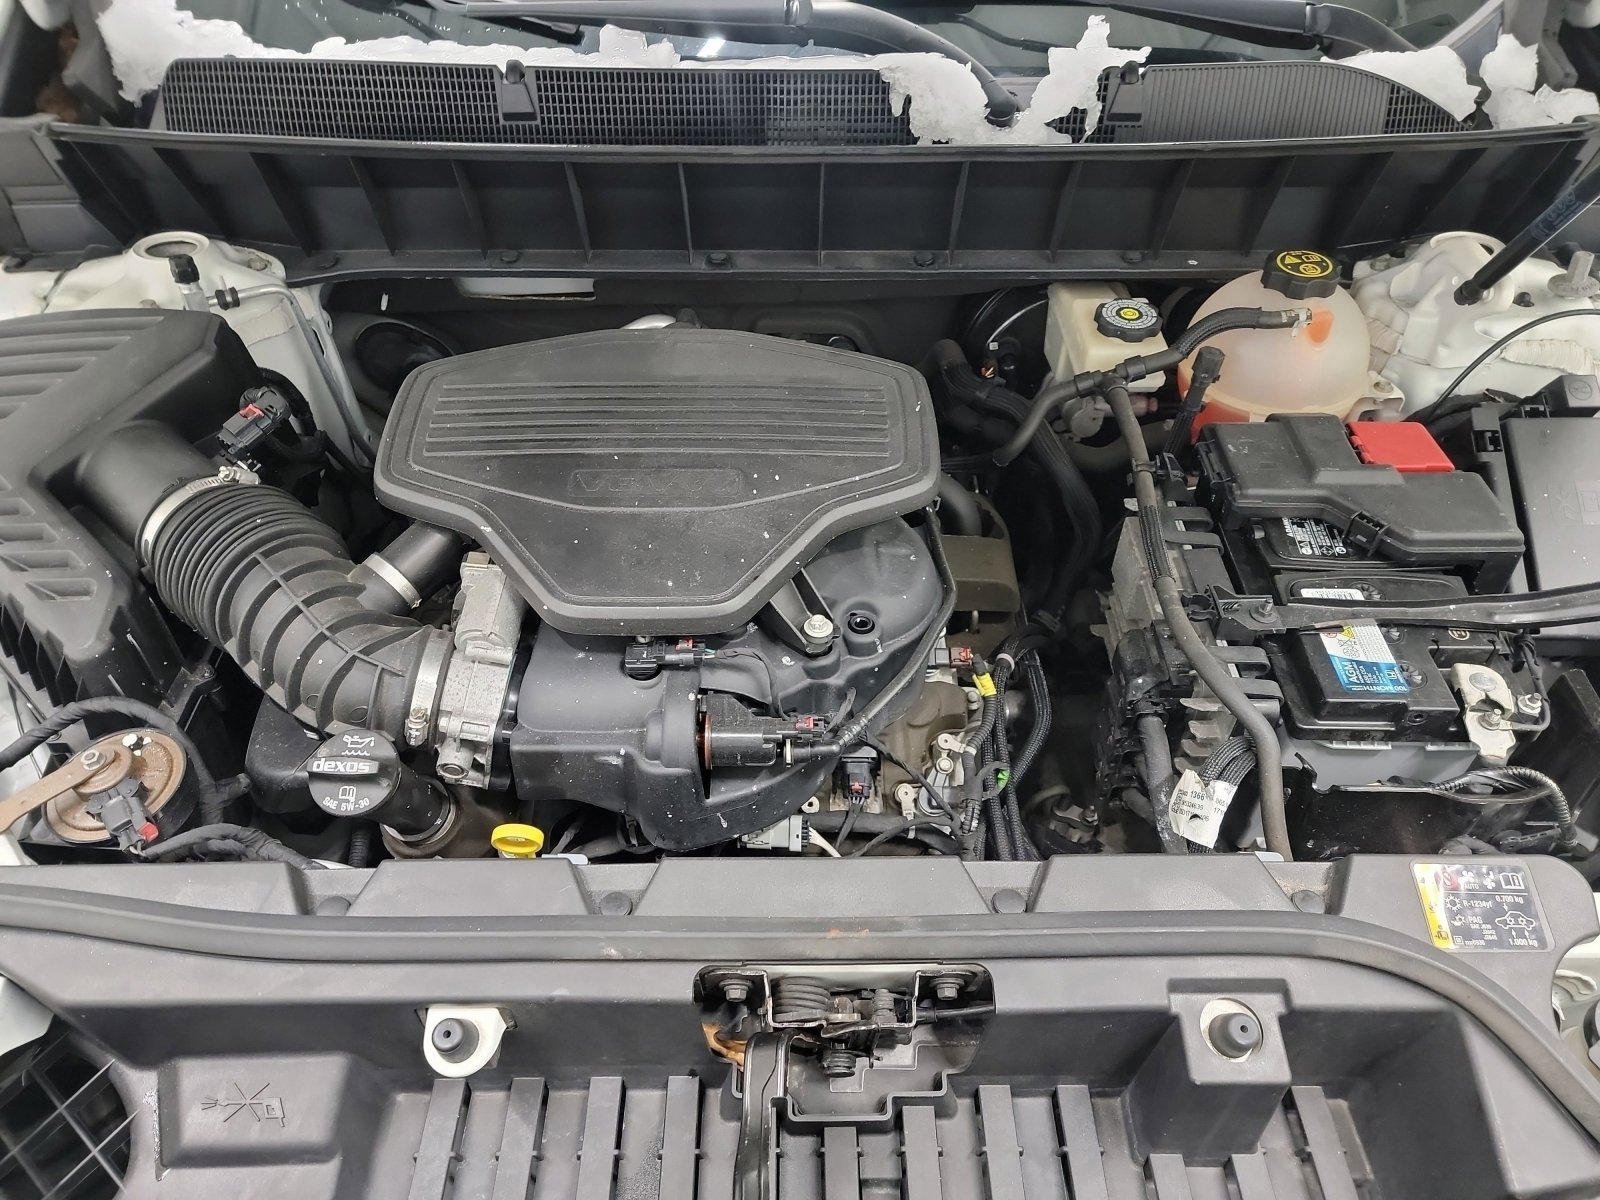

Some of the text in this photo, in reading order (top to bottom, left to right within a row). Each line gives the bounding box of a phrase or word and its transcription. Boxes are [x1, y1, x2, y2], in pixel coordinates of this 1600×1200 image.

[1342, 661, 1359, 683] AGM
[312, 757, 372, 773] dexos
[1190, 791, 1205, 801] 1366
[322, 796, 370, 811] SAE 5W-30
[1462, 900, 1492, 908] R-1234yf
[1514, 896, 1524, 904] kg
[1468, 916, 1482, 924] PAG
[1508, 938, 1538, 947] 1.000 kg
